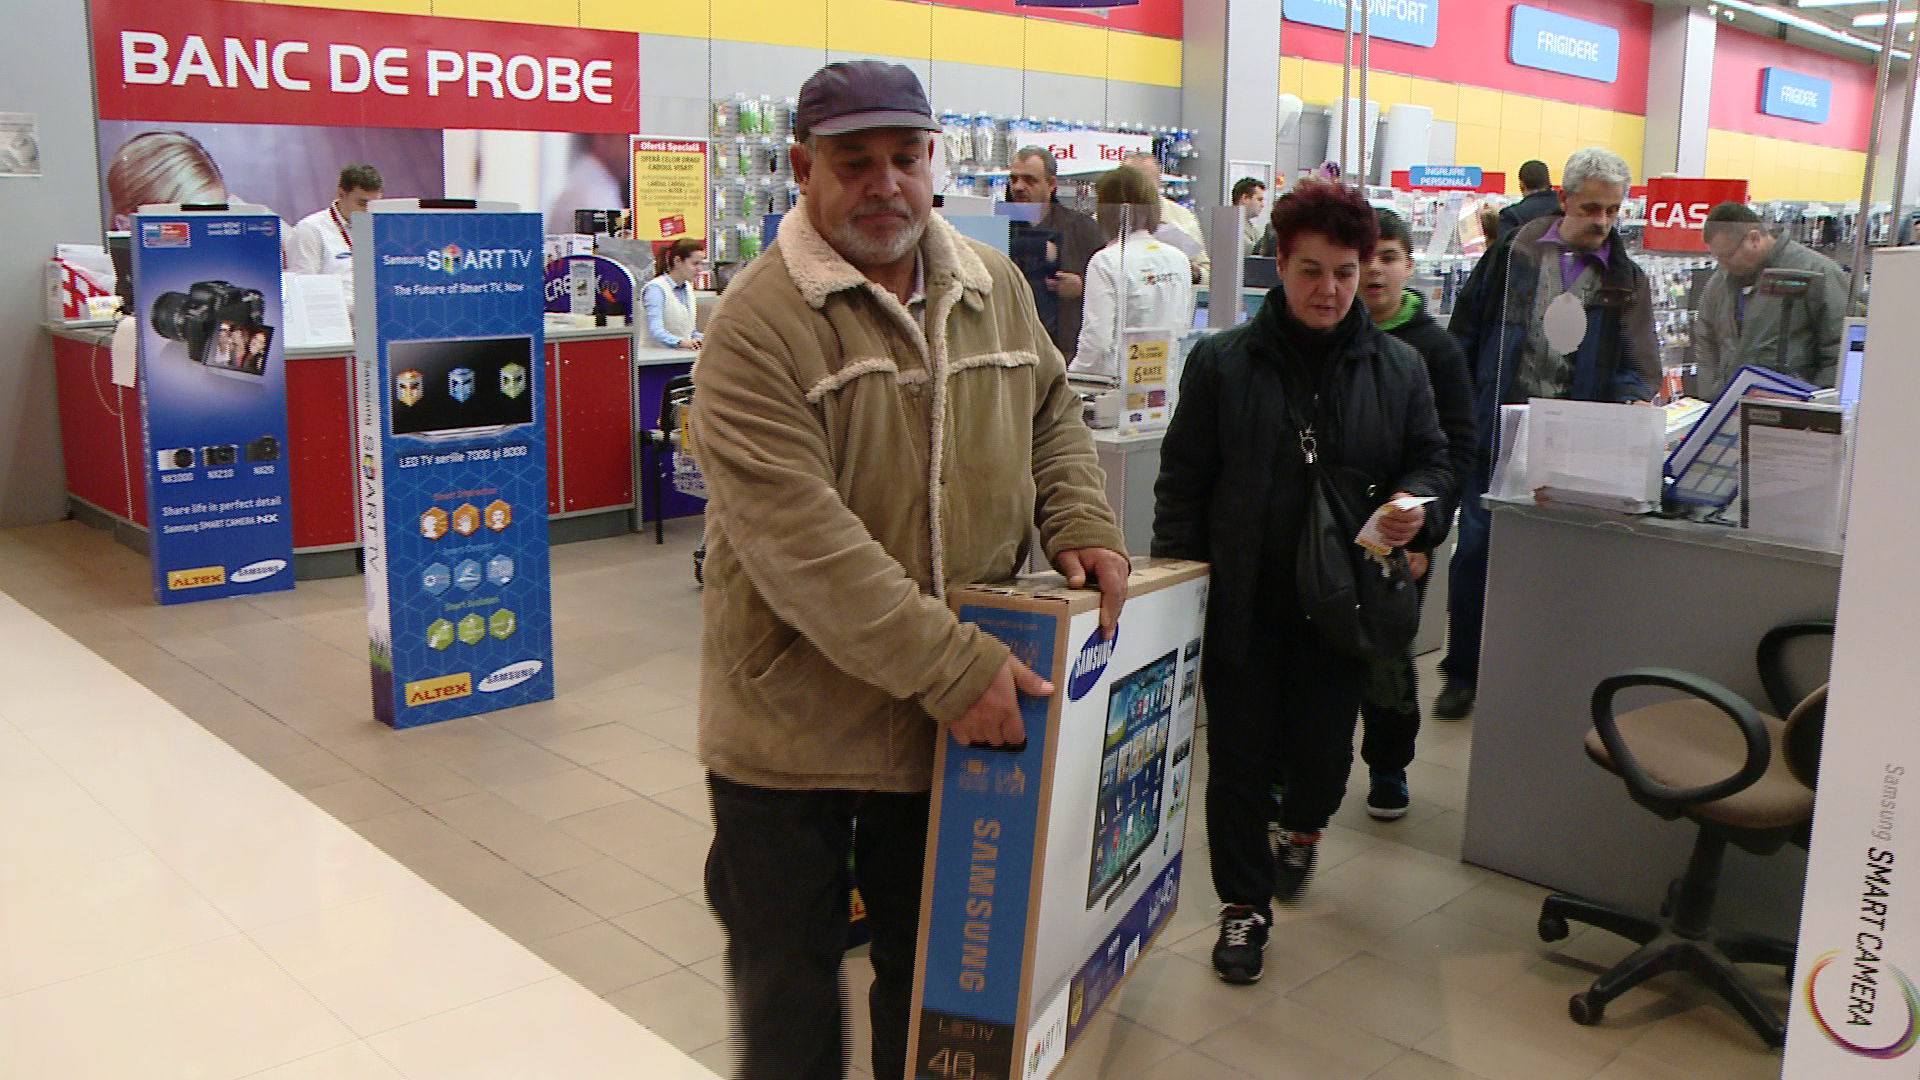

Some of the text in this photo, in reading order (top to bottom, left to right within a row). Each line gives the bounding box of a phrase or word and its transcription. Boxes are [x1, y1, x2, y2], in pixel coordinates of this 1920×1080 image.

[1537, 30, 1599, 63] FRIGIDERE
[120, 30, 614, 104] BANC DE PROBE
[1780, 84, 1818, 108] FRIGIDERE
[1048, 143, 1077, 160] fal
[1649, 202, 1710, 230] CAS
[382, 245, 533, 274] Samsung SMART TV
[394, 284, 412, 297] The
[413, 283, 446, 296] Future
[446, 282, 459, 295] of
[459, 281, 489, 295] Smart
[504, 281, 525, 293] Now
[1129, 344, 1139, 360] 2
[1133, 366, 1142, 384] 6
[399, 456, 419, 469] LED
[420, 455, 435, 466] TV
[466, 449, 492, 461] 7000
[502, 445, 528, 458] 8000
[161, 472, 194, 484] NX1000
[207, 468, 234, 480] NX210
[253, 465, 275, 475] NX20
[162, 496, 282, 517] Share life in perfect detail
[163, 513, 279, 534] Samsung SMART CAMERA NX
[238, 565, 280, 577] SAMSUNG
[1075, 638, 1114, 679] SAMSUNG
[486, 667, 536, 684] SAMSUNG
[958, 817, 1001, 993] SAMSUNG
[1846, 763, 1905, 1028] Samsung SMART CAMERA
[927, 1046, 977, 1080] 46
